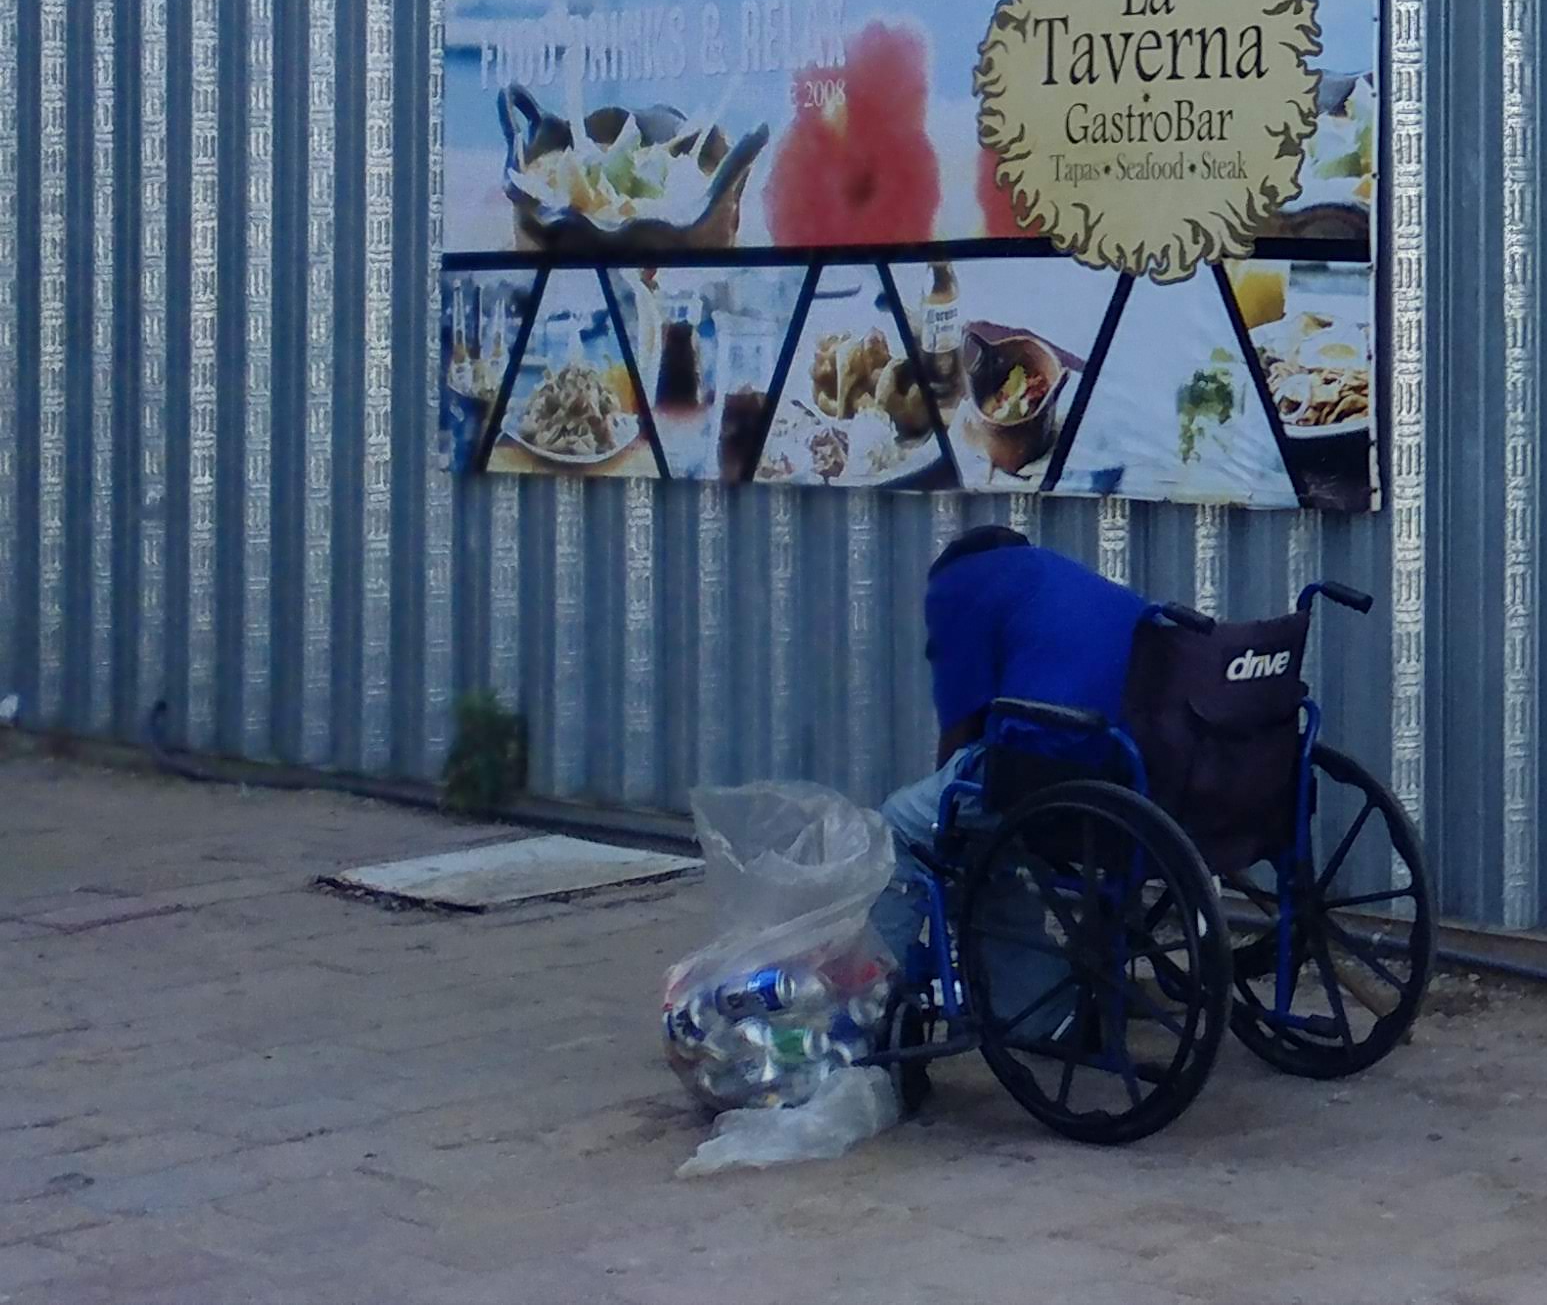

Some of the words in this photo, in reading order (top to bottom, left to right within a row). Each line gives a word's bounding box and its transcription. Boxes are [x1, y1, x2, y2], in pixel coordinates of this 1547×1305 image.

[1034, 16, 1270, 86] Taverna
[804, 78, 846, 109] 2008
[1064, 99, 1234, 145] GastroBar
[1050, 154, 1100, 187] Tapas
[1115, 151, 1185, 182] Seafood
[1200, 150, 1249, 180] Steak
[1226, 648, 1291, 682] drive
